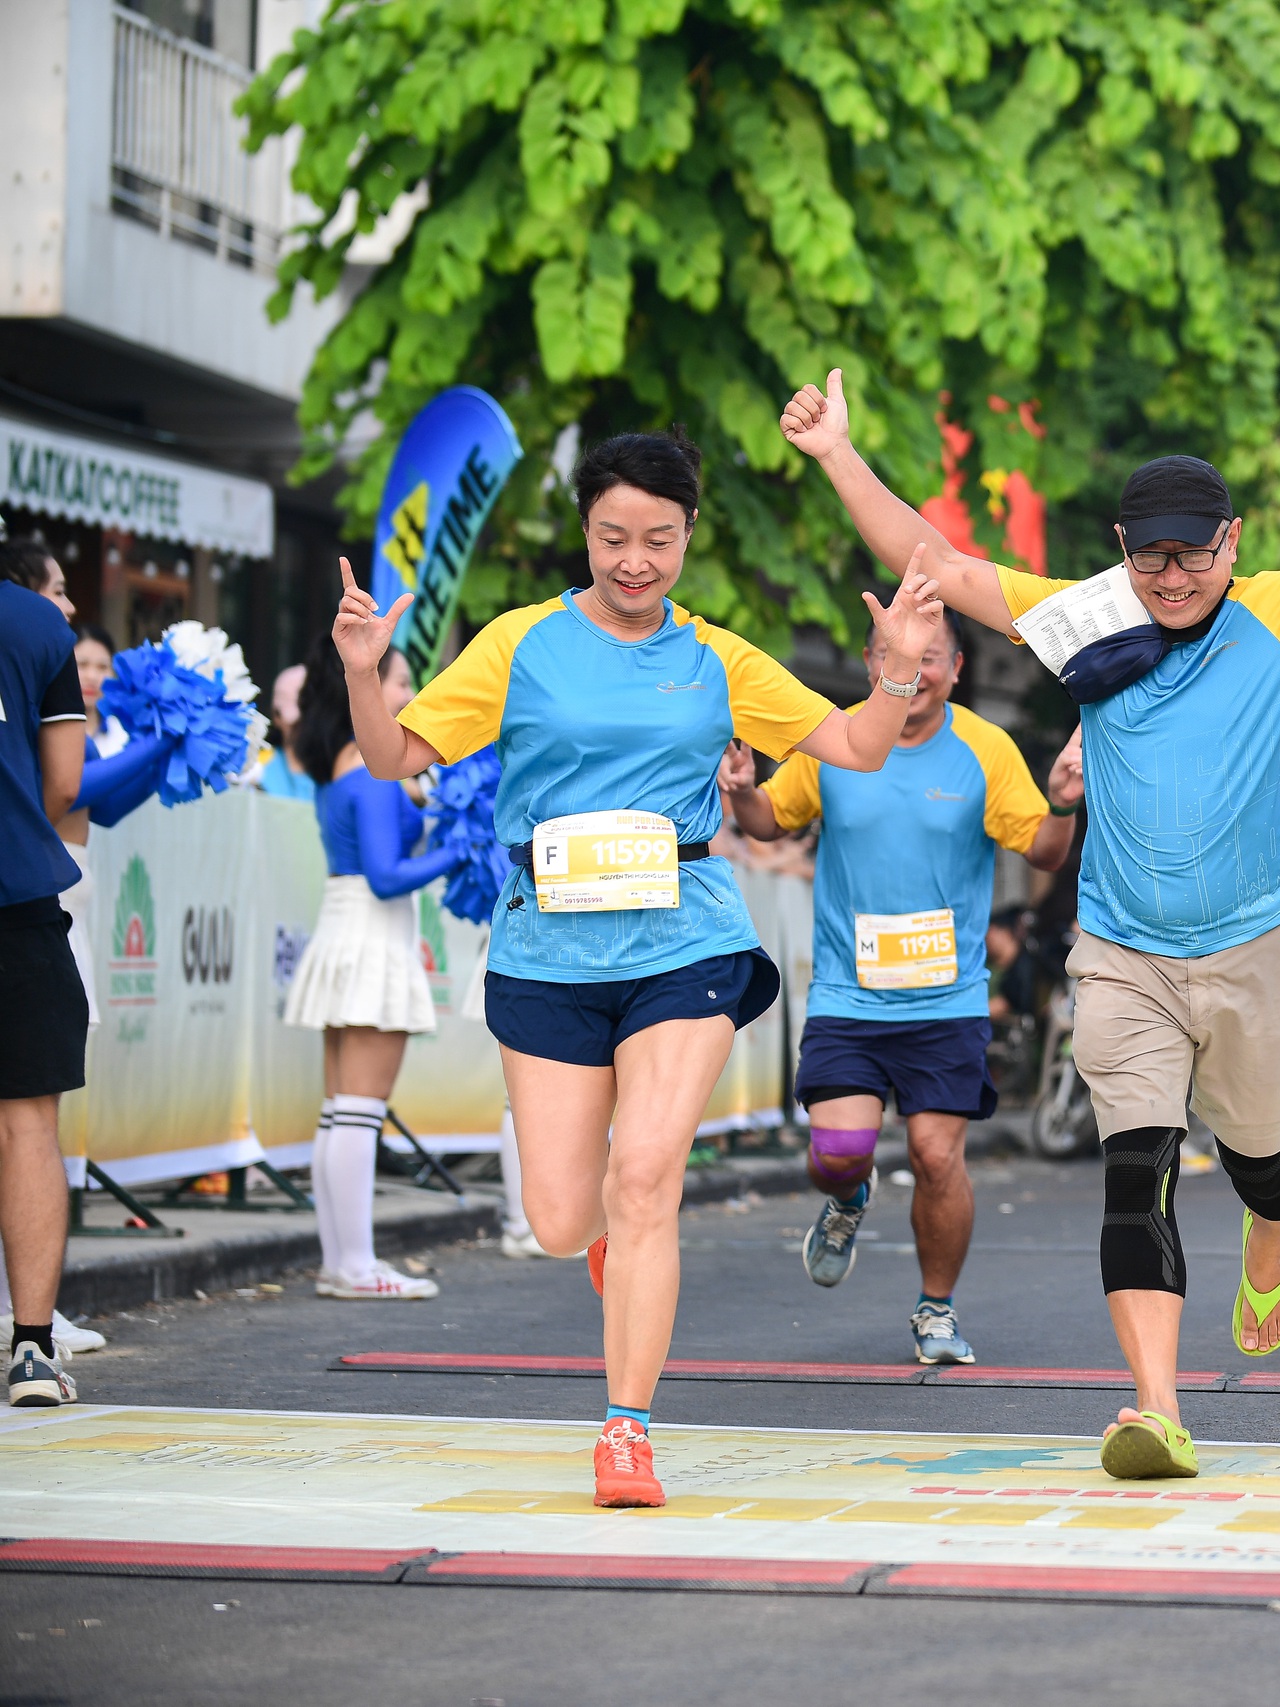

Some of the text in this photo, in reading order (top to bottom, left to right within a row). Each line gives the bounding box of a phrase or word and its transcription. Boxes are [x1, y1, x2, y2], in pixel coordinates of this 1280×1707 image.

[546, 839, 671, 865] F 11599
[861, 932, 952, 956] M 11915
